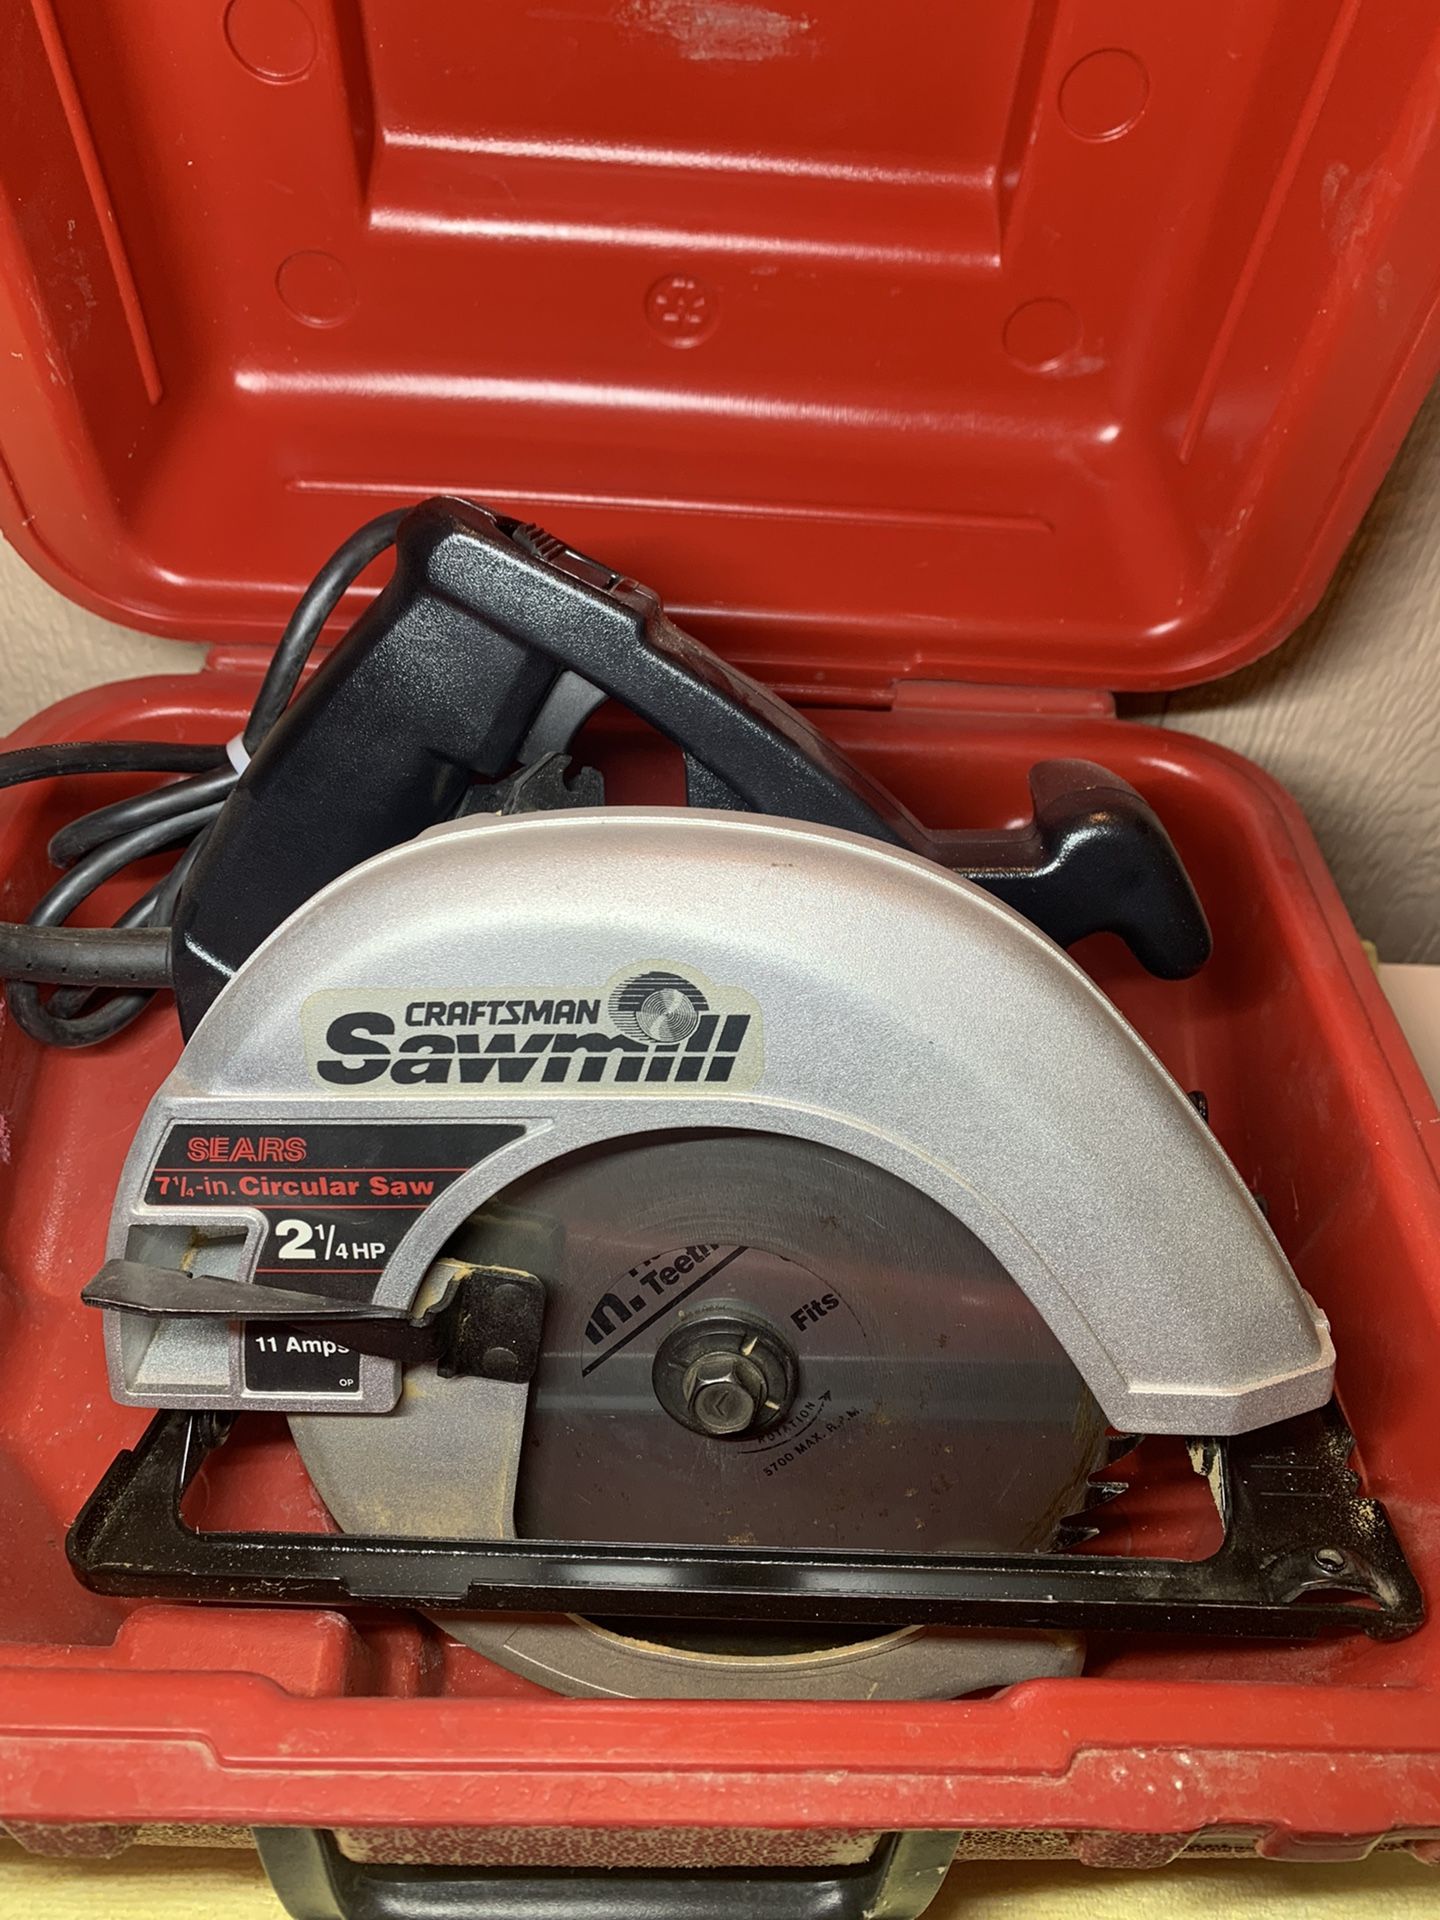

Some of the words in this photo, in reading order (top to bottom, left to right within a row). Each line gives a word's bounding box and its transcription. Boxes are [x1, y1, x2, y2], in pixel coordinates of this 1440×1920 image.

[405, 1000, 600, 1027] CRAFTSMAN
[317, 1012, 751, 1085] Sawmill
[187, 1137, 307, 1162] SEARS
[239, 1175, 360, 1197] Circular
[370, 1175, 434, 1196] Saw
[353, 1243, 386, 1260] HP
[790, 1293, 840, 1332] Fits
[255, 1336, 278, 1353] 11
[338, 1378, 355, 1387] OP
[758, 1401, 816, 1444] ROTATION
[762, 1452, 795, 1477] 5700
[794, 1432, 827, 1456] MAX.
